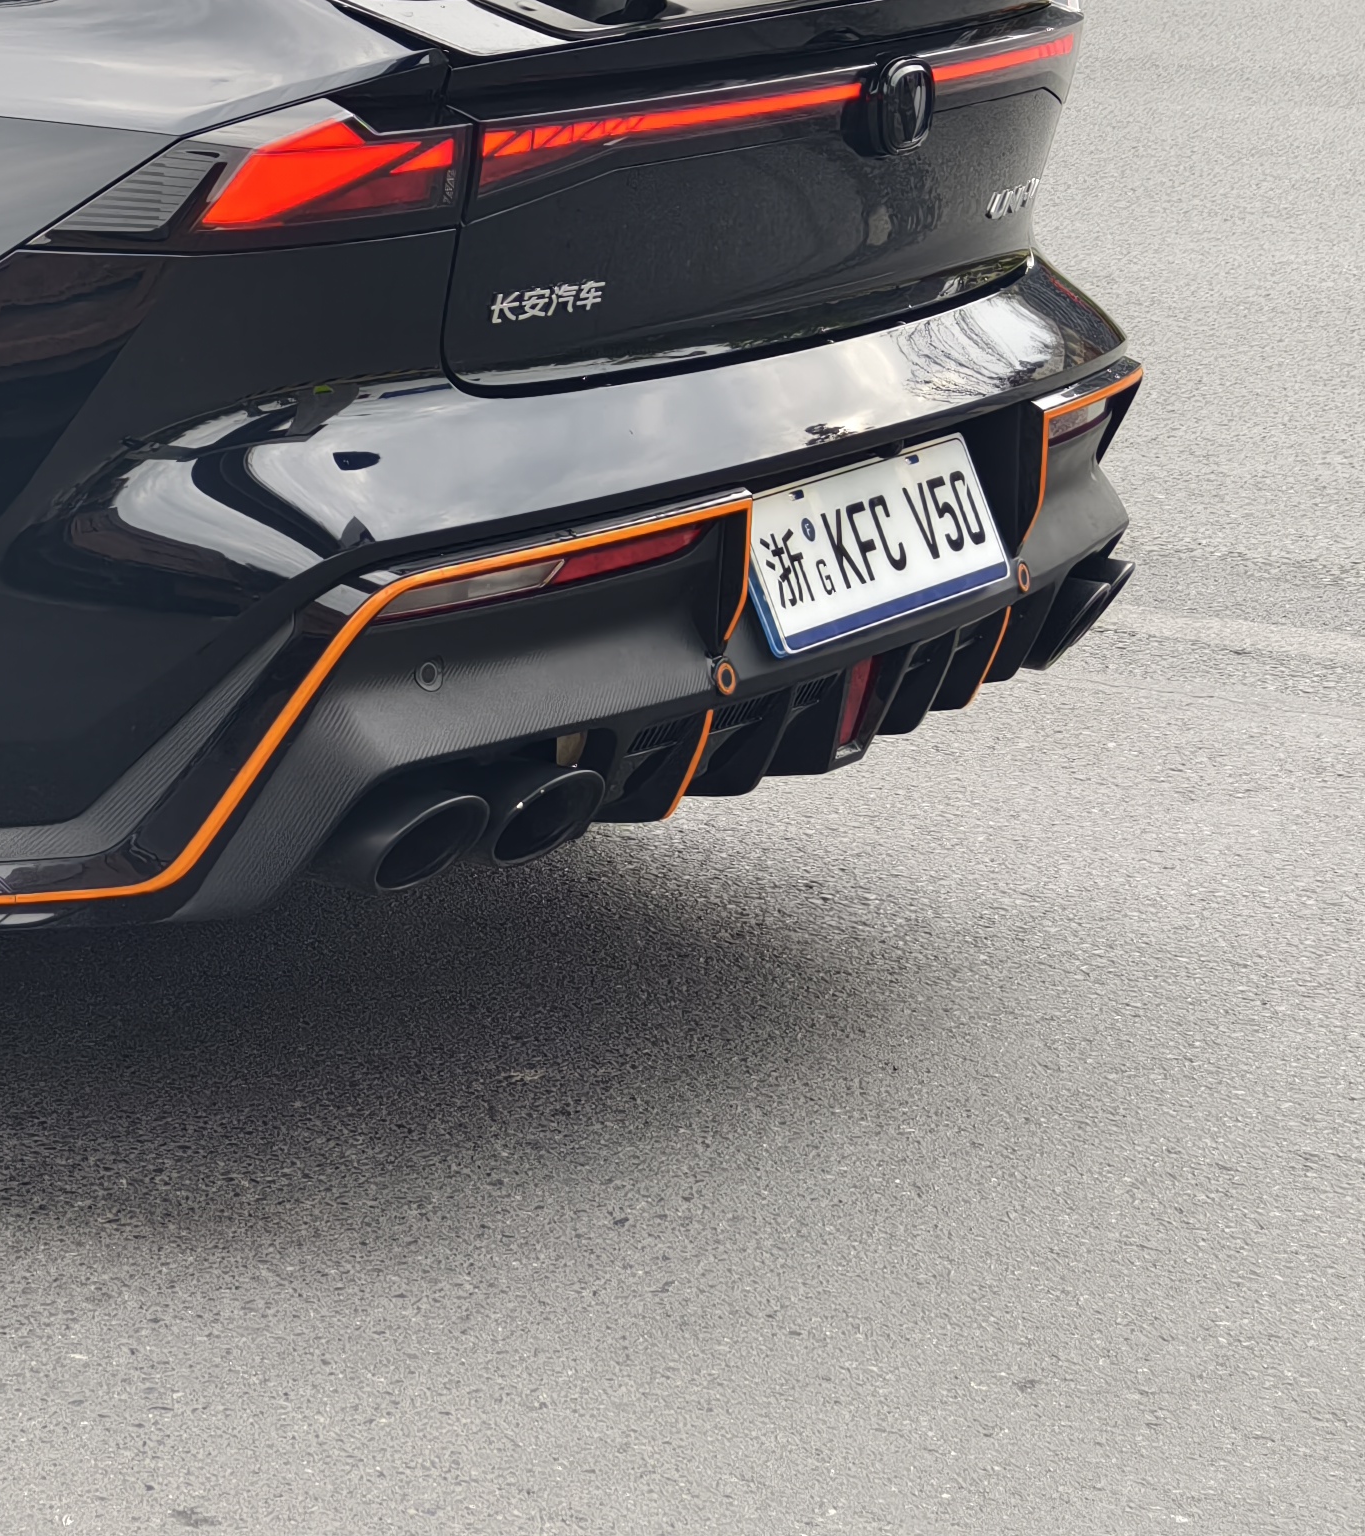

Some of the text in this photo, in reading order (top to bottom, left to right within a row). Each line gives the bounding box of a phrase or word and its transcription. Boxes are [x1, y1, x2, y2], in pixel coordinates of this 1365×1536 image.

[490, 280, 606, 324] 长安汽车
[820, 494, 907, 590] KFC
[901, 470, 986, 560] V50
